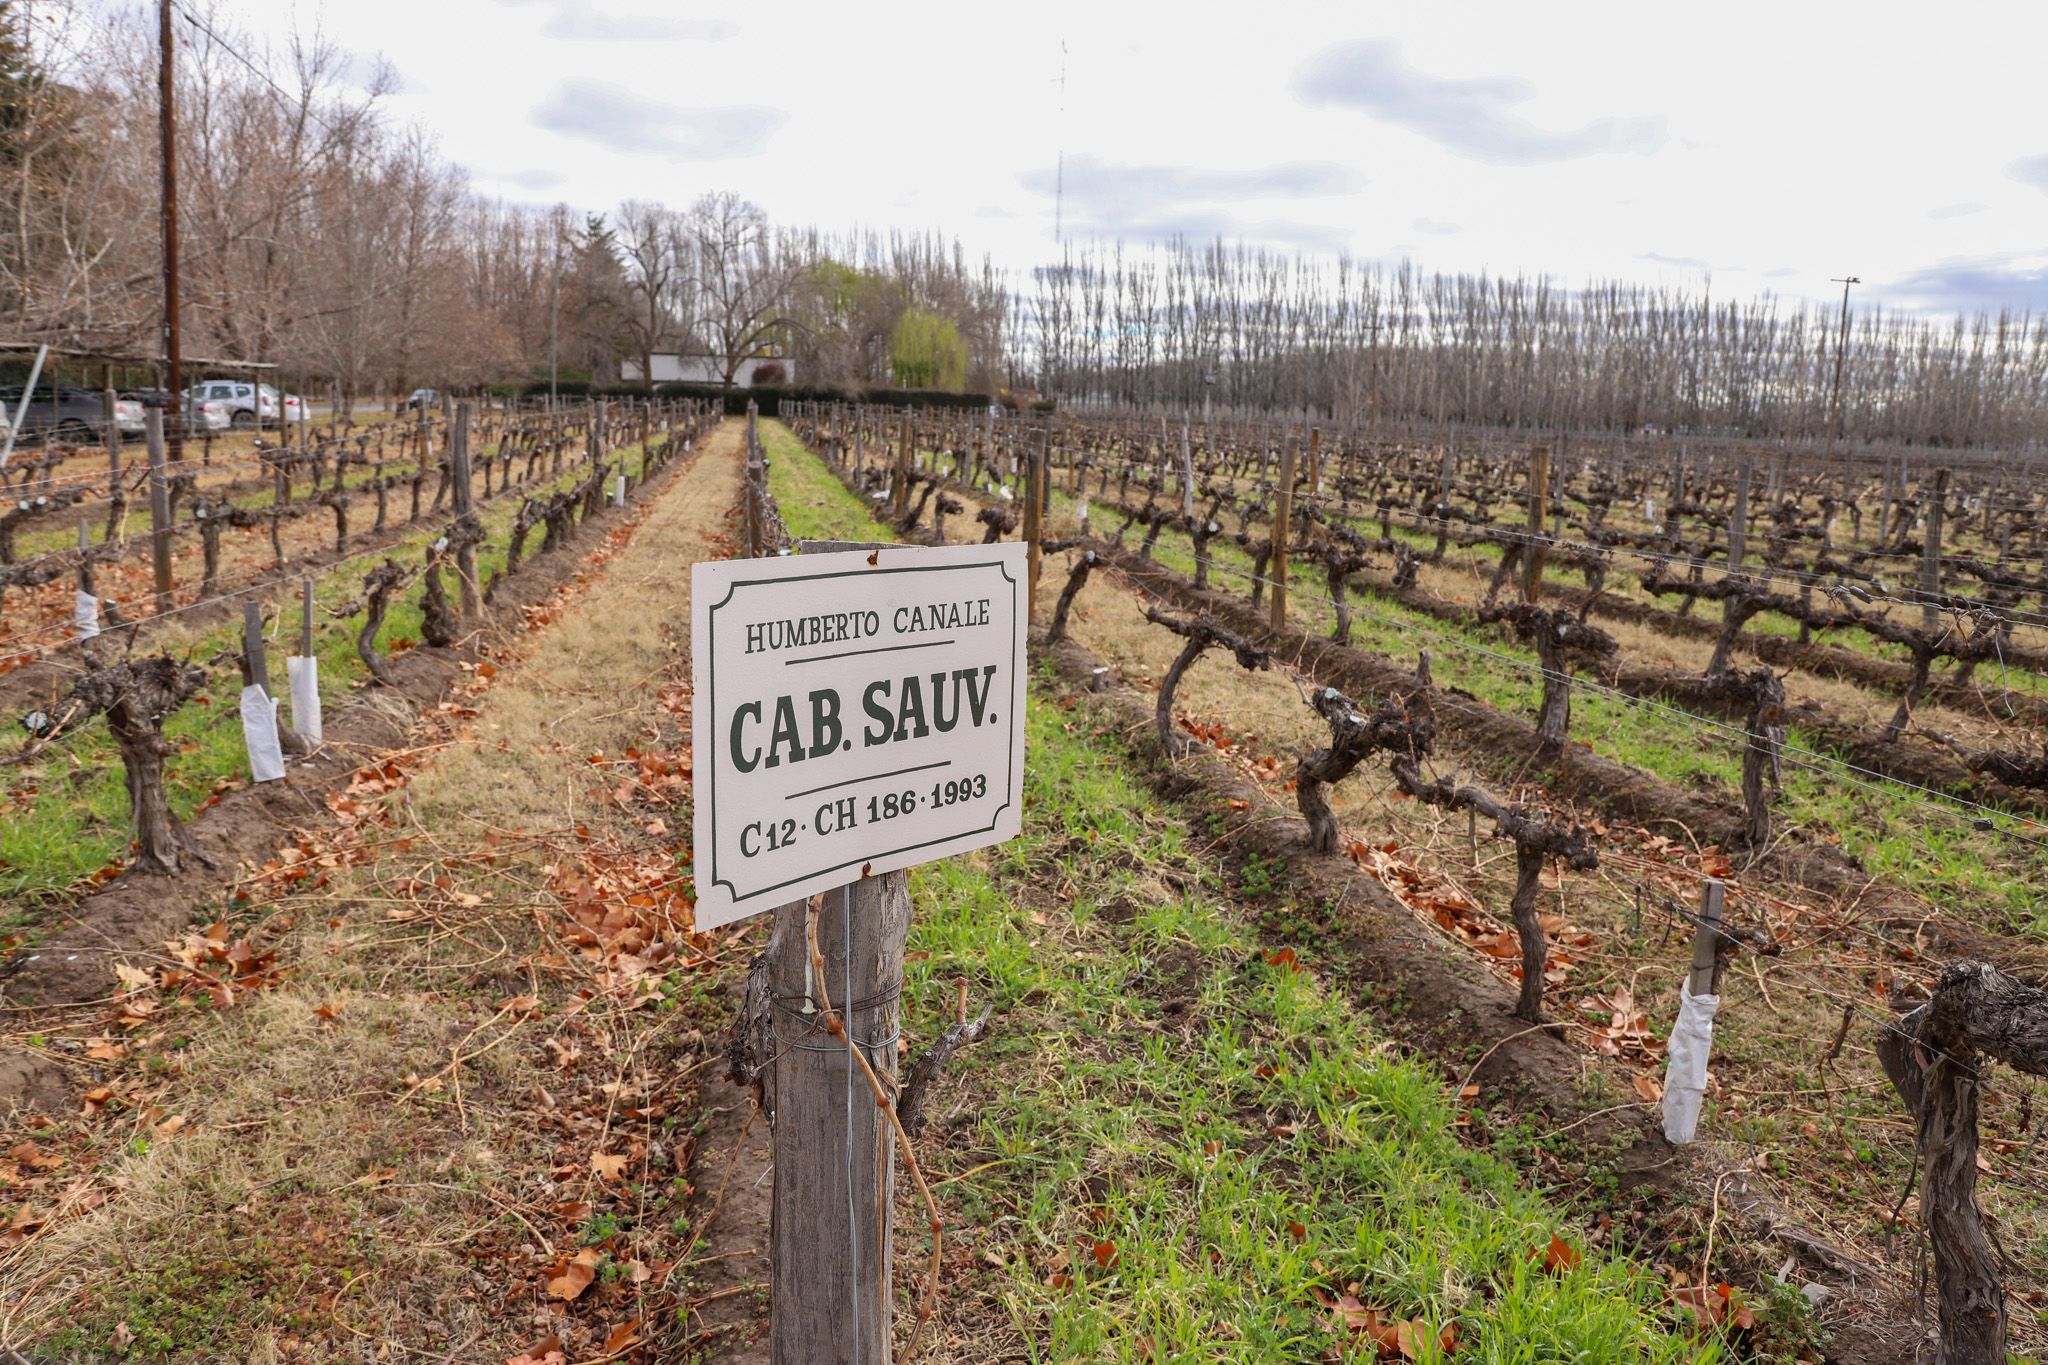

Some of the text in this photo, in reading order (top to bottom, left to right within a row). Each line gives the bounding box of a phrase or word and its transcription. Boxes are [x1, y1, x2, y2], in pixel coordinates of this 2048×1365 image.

[745, 599, 990, 655] HUMBERTO CANALE
[730, 665, 998, 774] CAB. SAUV.
